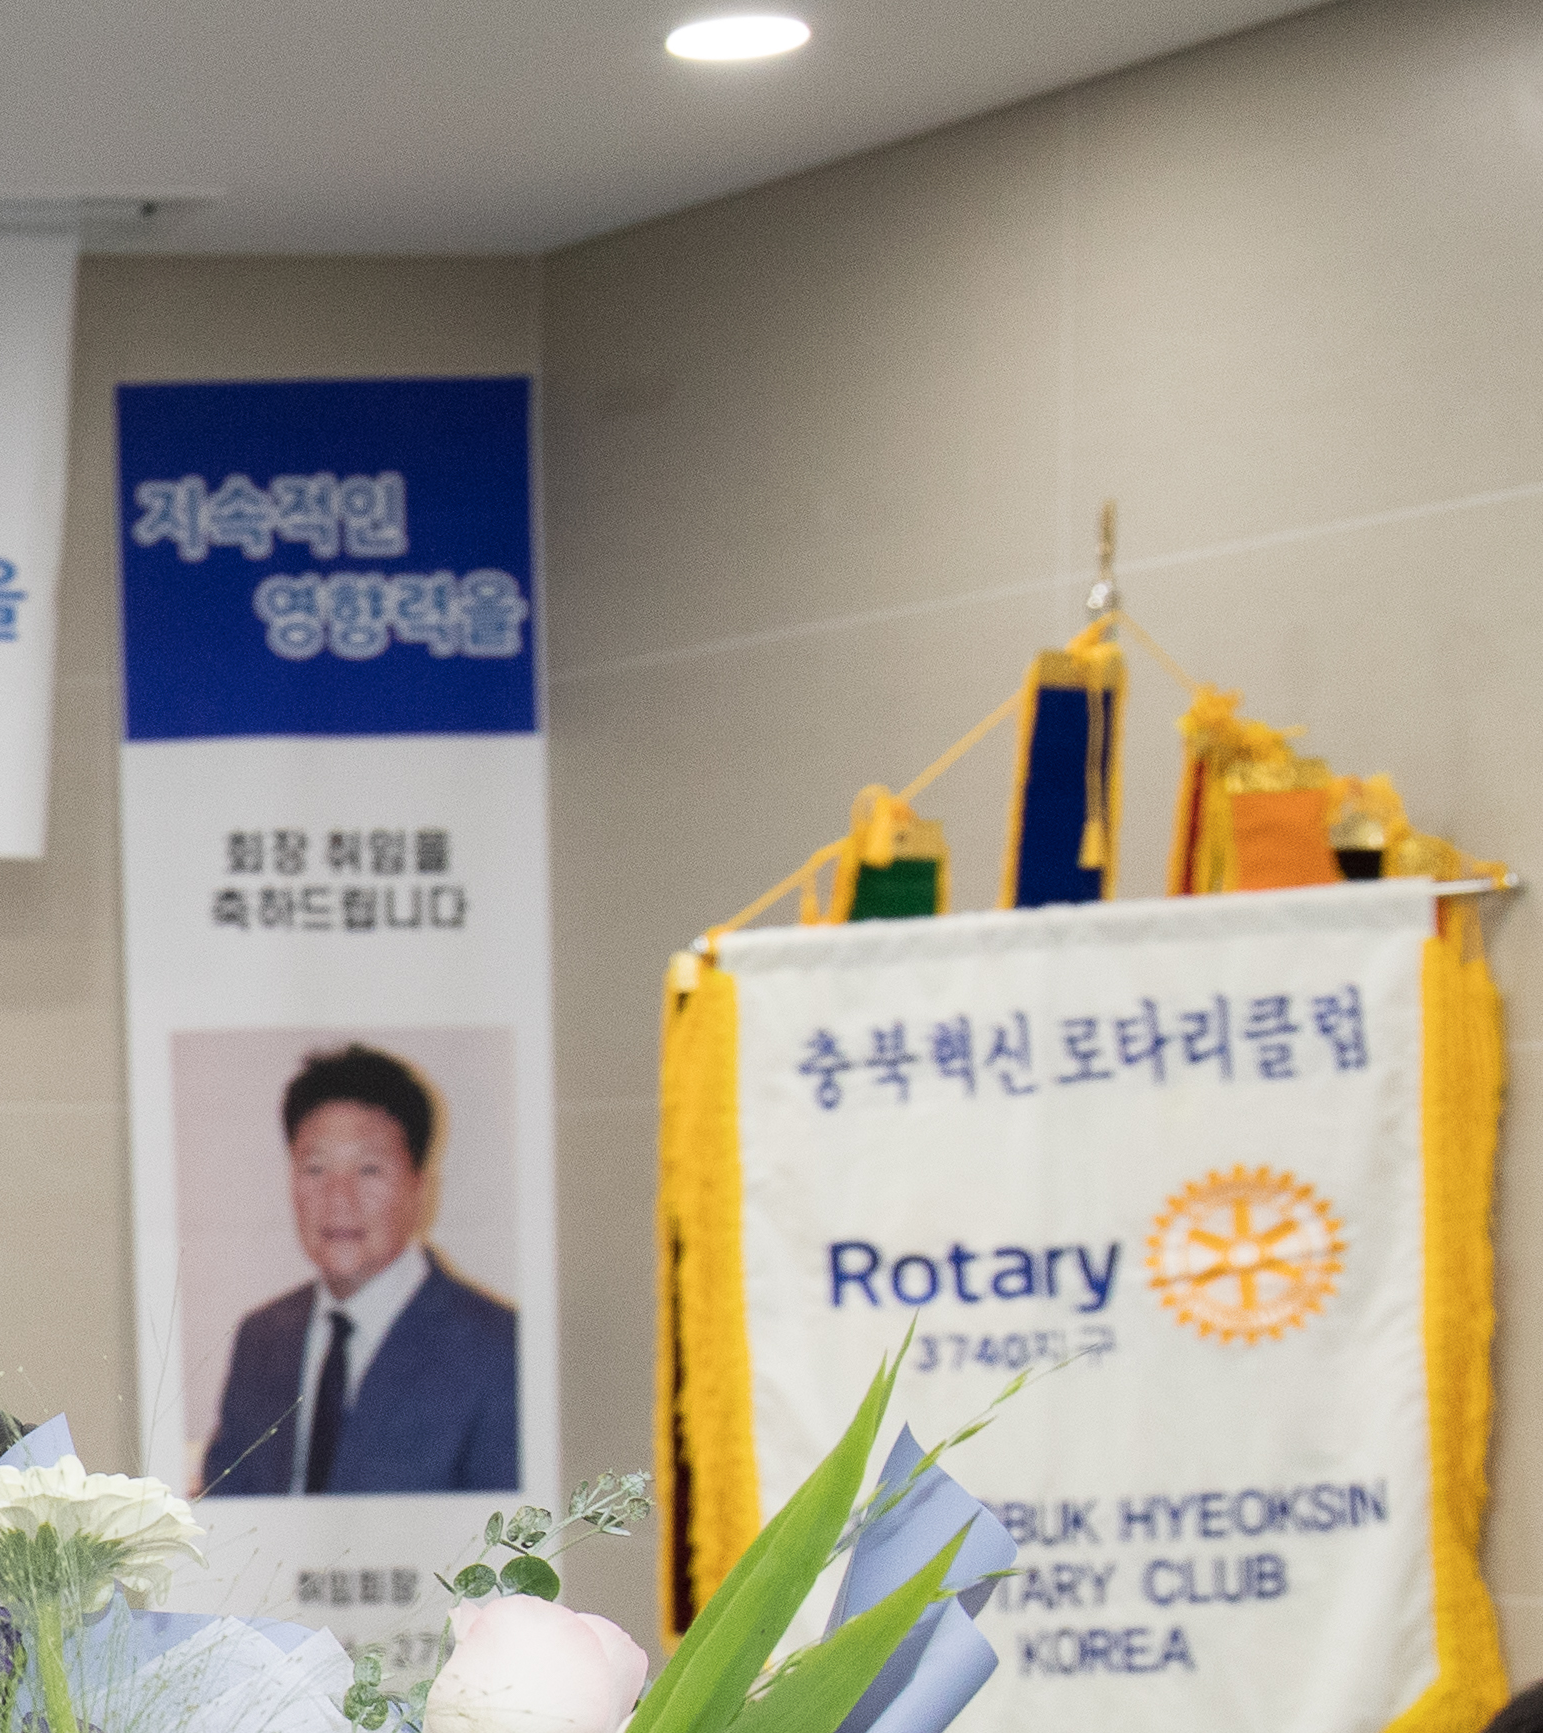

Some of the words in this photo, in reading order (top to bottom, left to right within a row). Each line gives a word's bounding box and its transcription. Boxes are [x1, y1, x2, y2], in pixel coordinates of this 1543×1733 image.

[134, 468, 408, 560] 지속적인
[254, 567, 525, 659] 영향력을
[225, 830, 309, 879] 회장
[799, 1012, 1040, 1113] 충북혁신
[1057, 983, 1372, 1085] 로타리클럽
[827, 1238, 1122, 1315] Rotary
[917, 1323, 1118, 1375] 3740지구
[1115, 1477, 1391, 1545] HYEOKSIN
[1140, 1551, 1289, 1608] CLUB
[1015, 1624, 1199, 1679] KOREA
